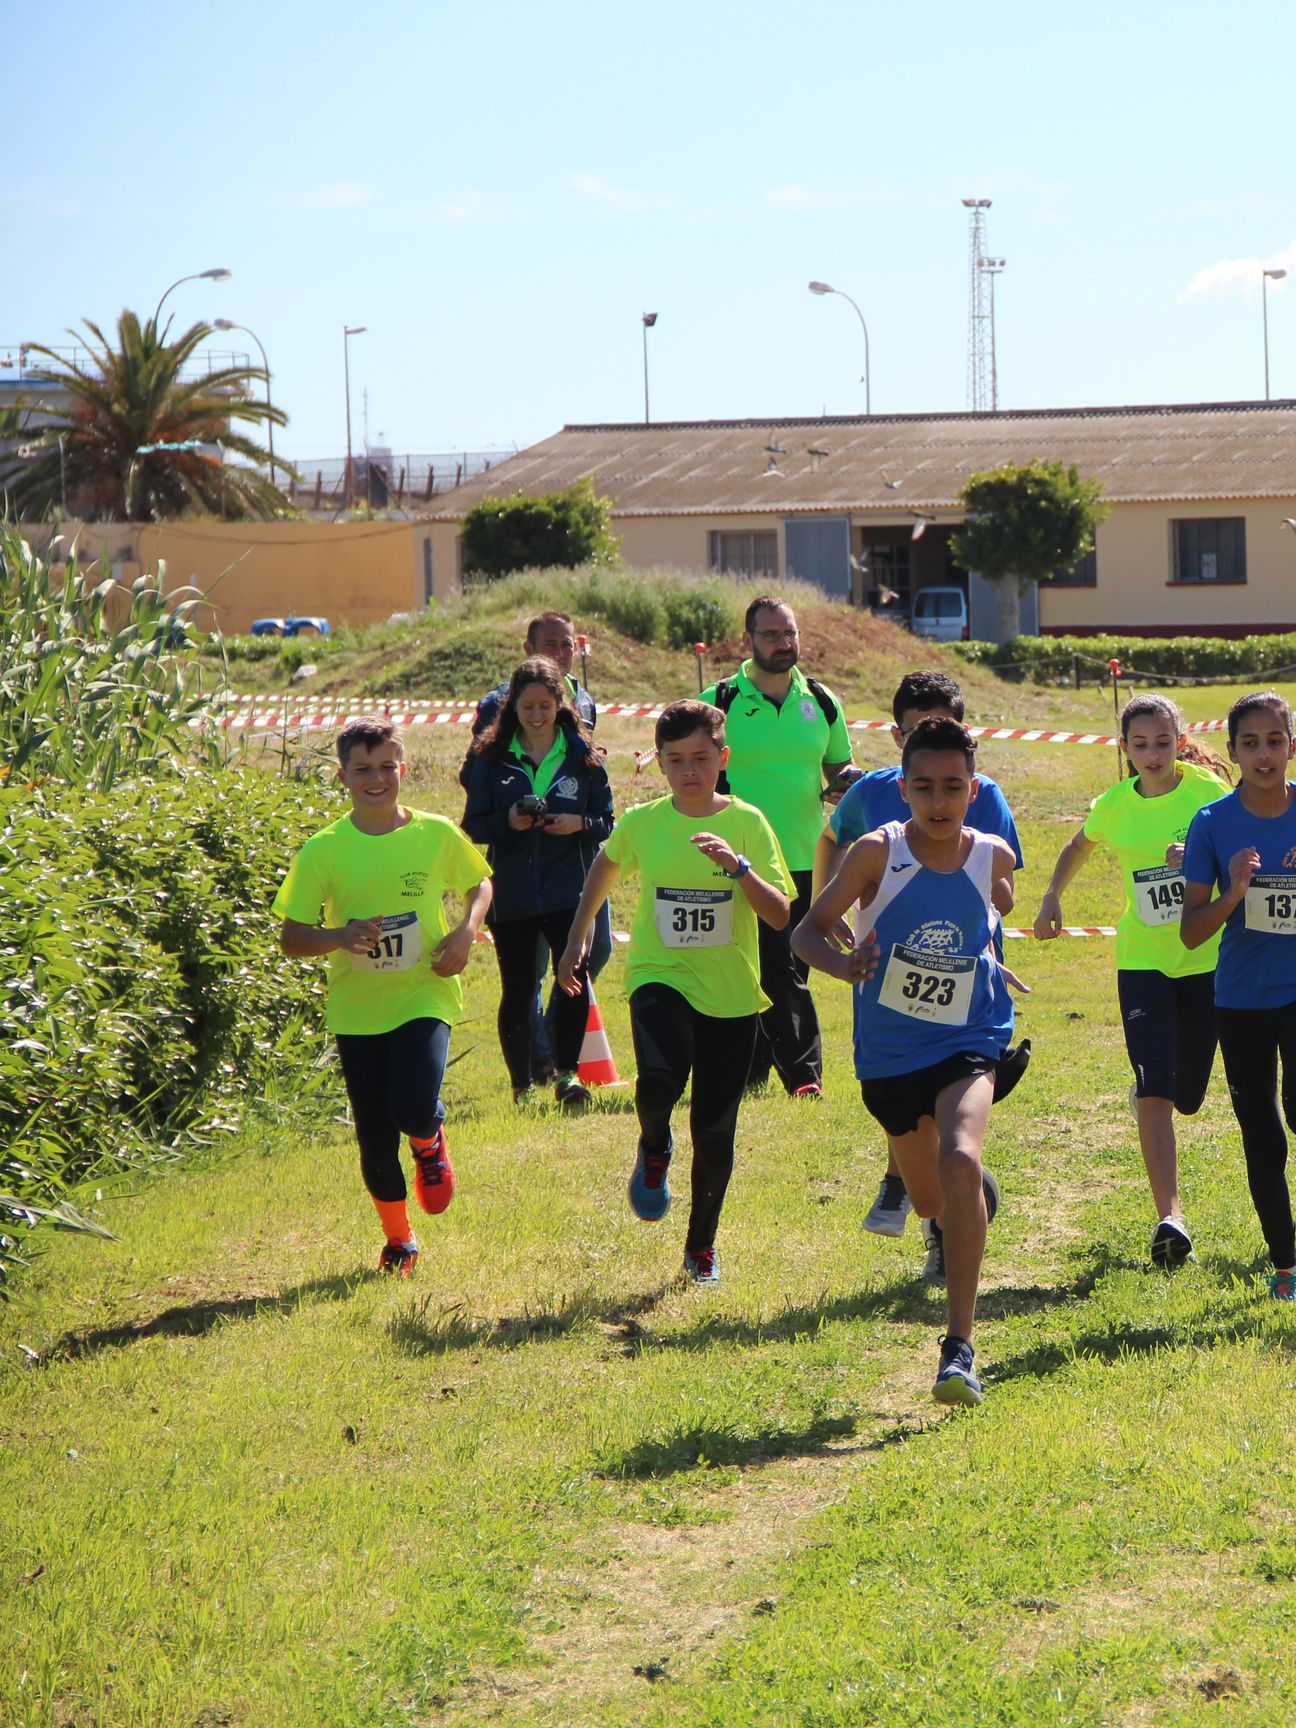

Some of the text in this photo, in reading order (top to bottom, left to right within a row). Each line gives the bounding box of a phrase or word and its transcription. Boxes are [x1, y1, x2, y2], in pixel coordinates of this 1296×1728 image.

[664, 888, 694, 896] FEDERACIÓN
[1147, 881, 1184, 910] 149
[672, 907, 715, 932] 315
[367, 933, 403, 959] 317
[903, 949, 968, 966] FEDERACIÓN MELILLENSE
[925, 962, 954, 971] ATLETISMO
[902, 971, 956, 1006] 323
